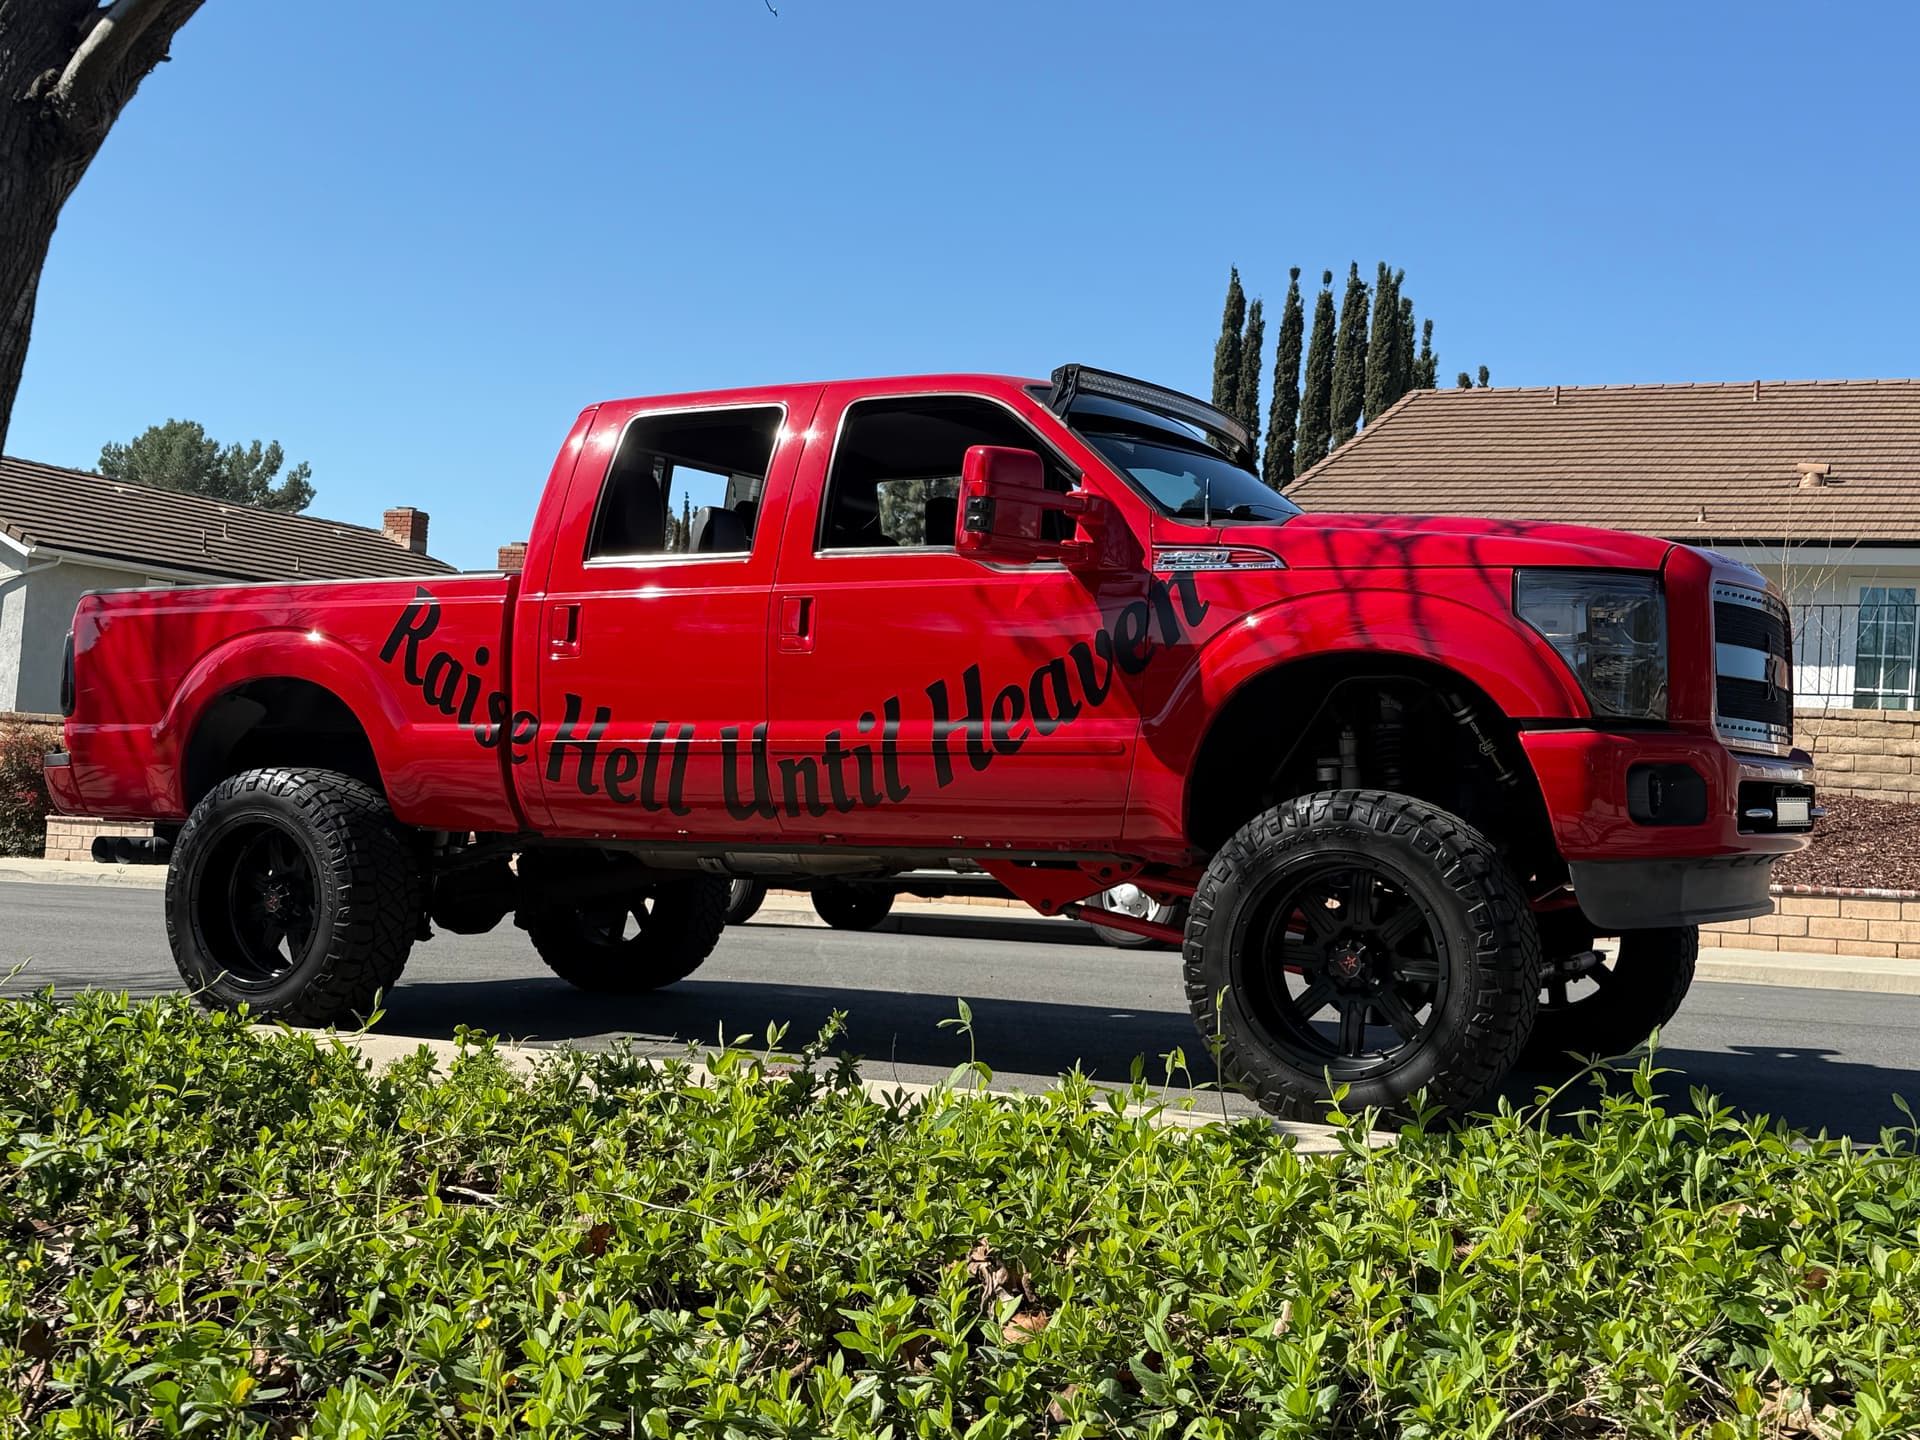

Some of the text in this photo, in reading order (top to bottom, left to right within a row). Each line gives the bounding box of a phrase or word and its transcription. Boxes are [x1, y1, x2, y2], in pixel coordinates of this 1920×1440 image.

[378, 571, 1209, 821] Raise Hell Until Heaven
